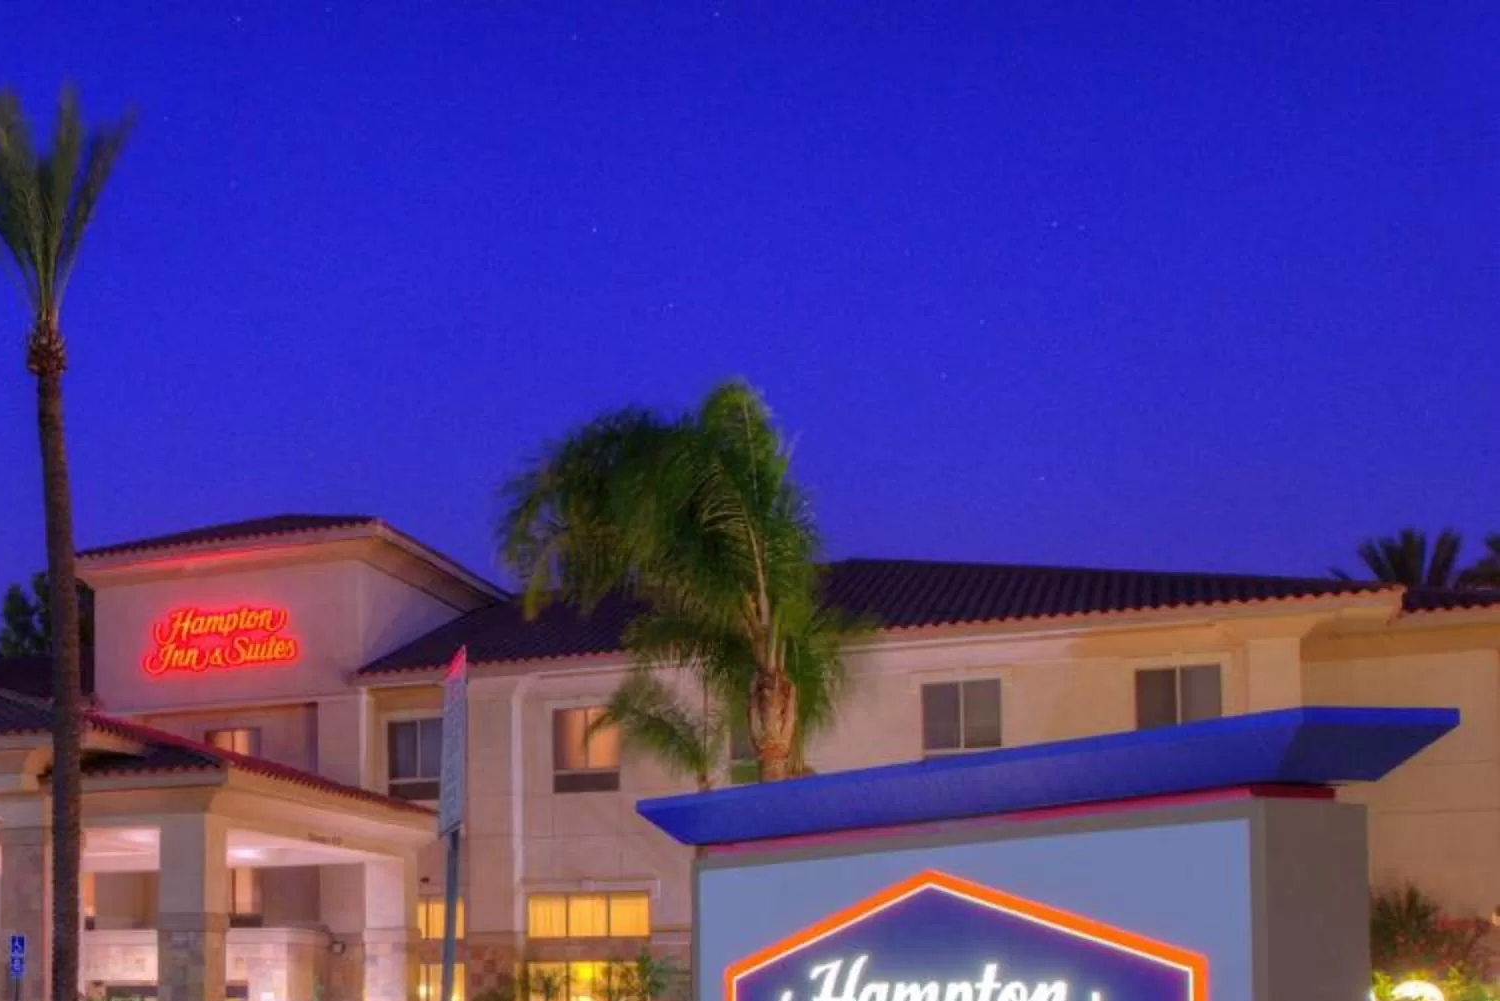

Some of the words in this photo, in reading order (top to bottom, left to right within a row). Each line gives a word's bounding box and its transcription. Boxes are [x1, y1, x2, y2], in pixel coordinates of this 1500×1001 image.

[155, 607, 287, 645] Hampton
[145, 643, 210, 674] Inn
[209, 648, 225, 667] &
[225, 634, 297, 665] Suites
